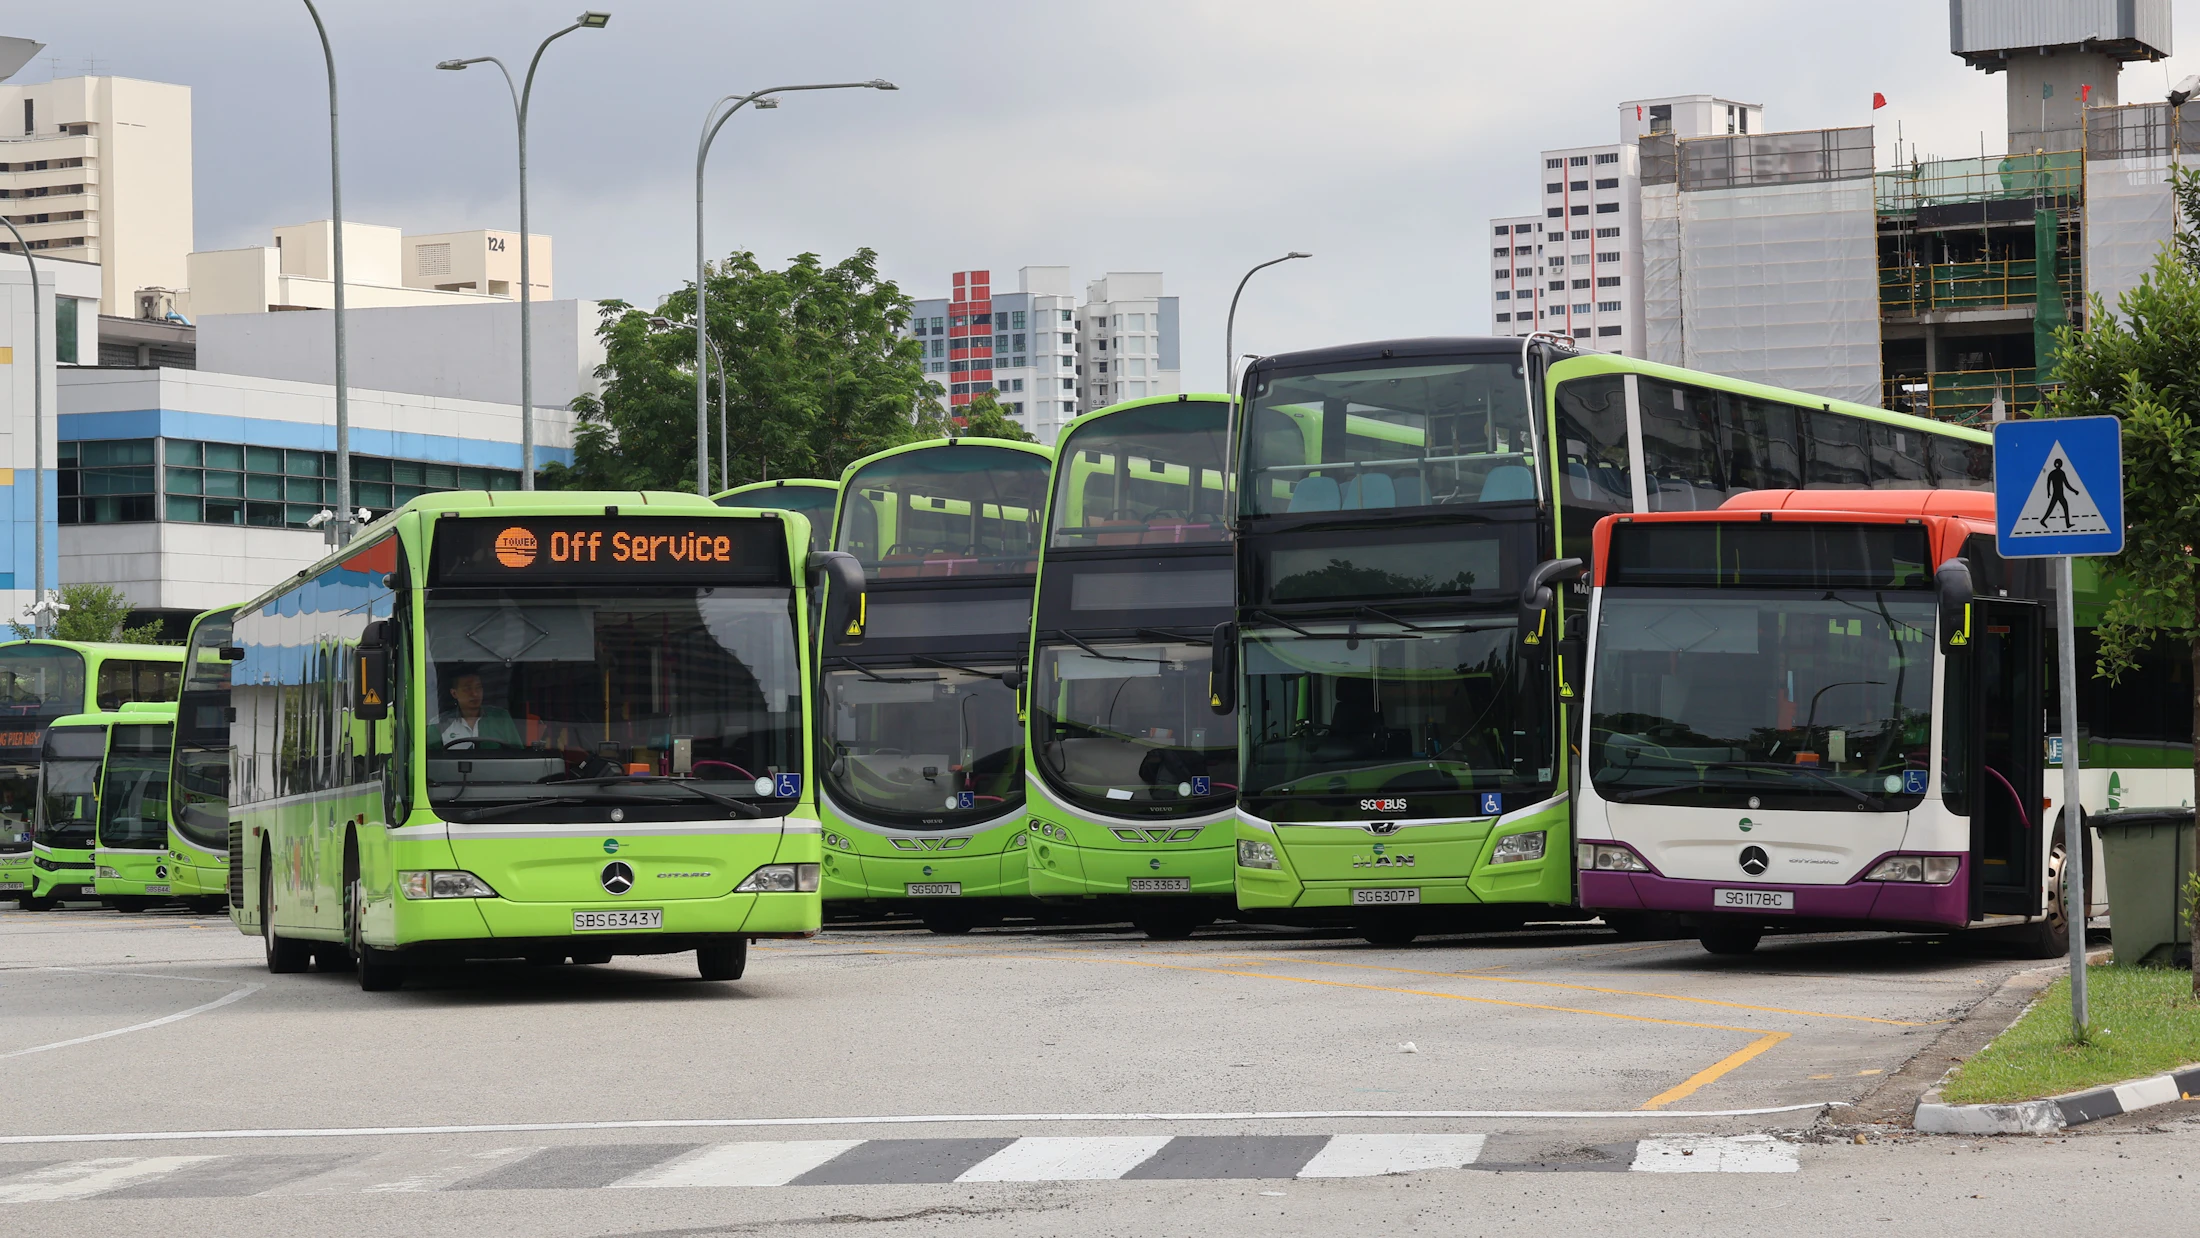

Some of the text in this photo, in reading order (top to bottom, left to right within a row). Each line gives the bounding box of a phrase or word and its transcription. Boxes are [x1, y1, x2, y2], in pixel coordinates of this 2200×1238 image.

[488, 237, 506, 252] 124
[503, 537, 536, 547] TOWER
[551, 531, 730, 562] Off Service
[8, 731, 23, 746] PIER
[1352, 853, 1415, 868] MAN
[911, 884, 957, 895] SG5007L
[1131, 880, 1189, 890] SBS3363J
[1357, 890, 1415, 903] SG6307P
[1725, 891, 1782, 906] SG1178C
[575, 912, 660, 928] SBS6343Y
